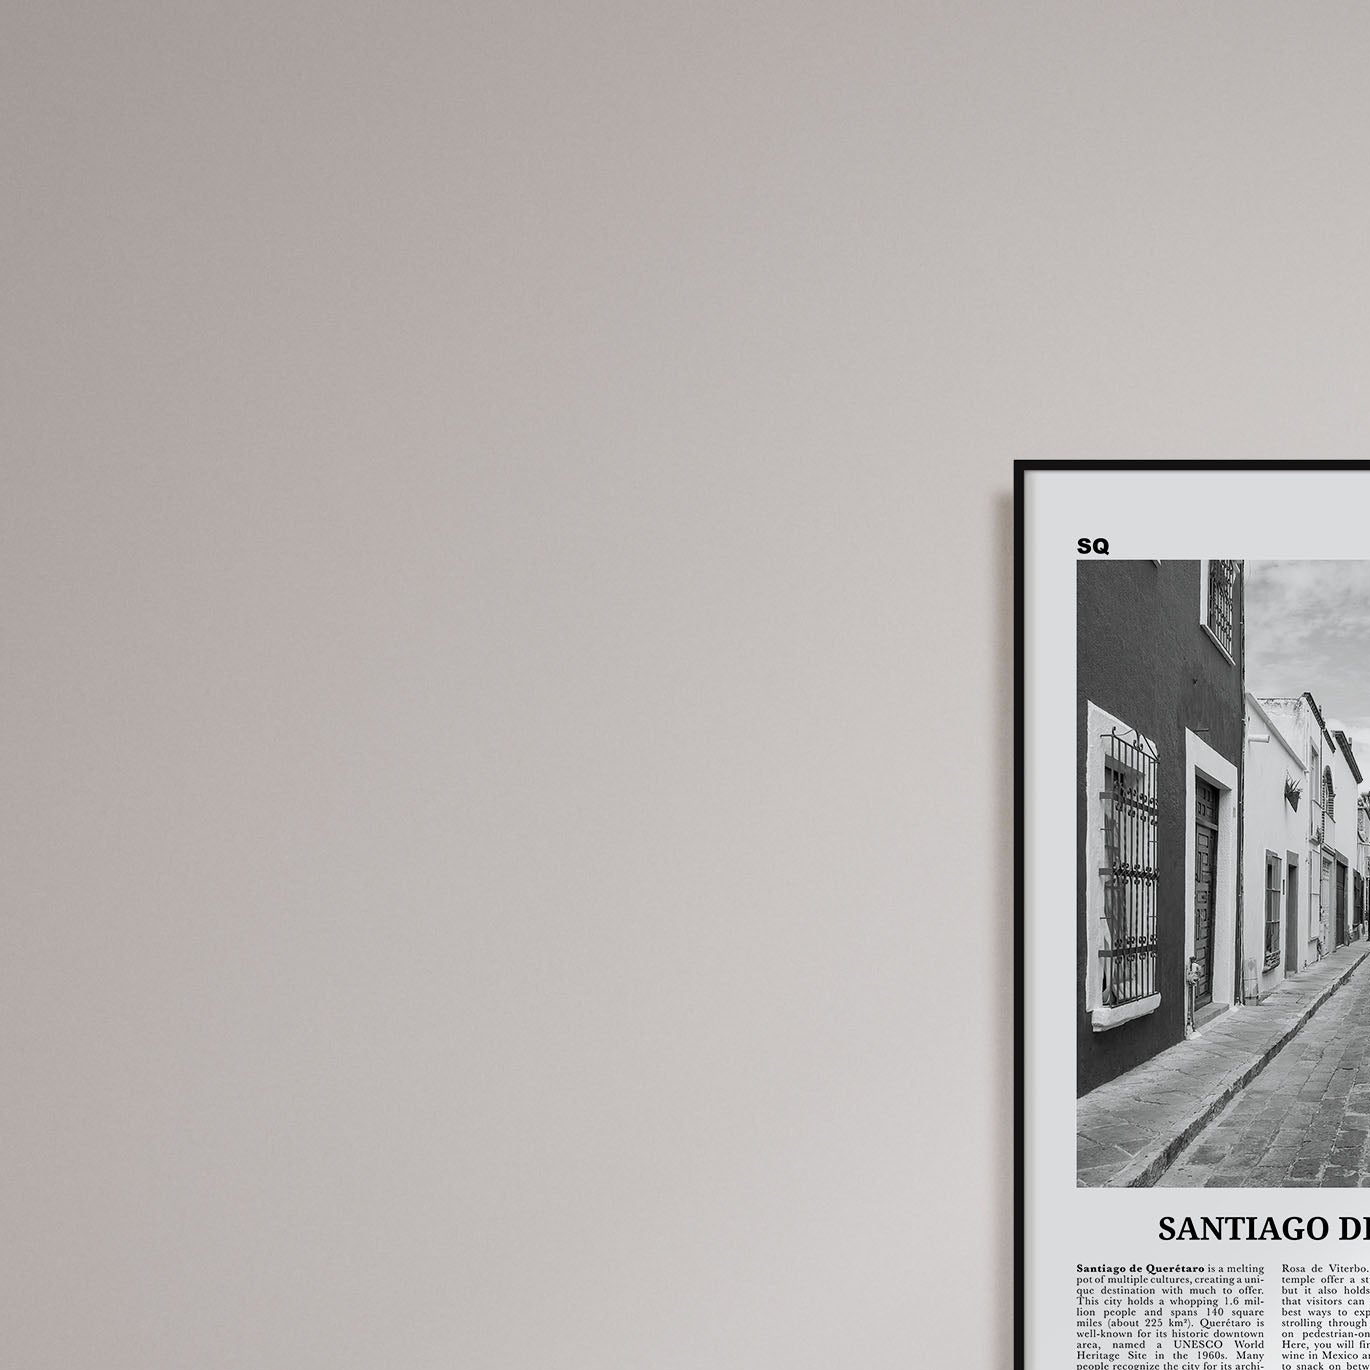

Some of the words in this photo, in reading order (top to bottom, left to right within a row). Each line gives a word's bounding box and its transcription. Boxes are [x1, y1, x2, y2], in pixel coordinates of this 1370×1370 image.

[1077, 538, 1109, 555] SQ
[1159, 1217, 1329, 1240] SANTIAGO
[1077, 1264, 1126, 1276] Santiago
[1129, 1264, 1143, 1273] de
[1146, 1264, 1205, 1276] Querétaro
[1208, 1264, 1215, 1273] is
[1218, 1265, 1224, 1273] a
[1227, 1264, 1264, 1276] melting
[1282, 1264, 1306, 1273] Rosa
[1311, 1264, 1323, 1273] de
[1329, 1264, 1369, 1273] Viterbo.
[1076, 1275, 1093, 1286] pot
[1094, 1275, 1106, 1284] of
[1108, 1275, 1148, 1286] multiple
[1150, 1275, 1192, 1285] cultures,
[1194, 1275, 1235, 1286] creating
[1236, 1276, 1242, 1284] a
[1244, 1275, 1264, 1284] uni-
[1282, 1275, 1315, 1286] temple
[1321, 1275, 1344, 1284] offer
[1349, 1276, 1355, 1284] a
[1076, 1297, 1099, 1305] This
[1104, 1297, 1122, 1308] city
[1127, 1297, 1154, 1305] holds
[1170, 1297, 1218, 1308] whopping
[1225, 1297, 1239, 1305] 1.6
[1244, 1297, 1264, 1305] mil-
[1282, 1297, 1301, 1305] that
[1306, 1297, 1342, 1305] visitors
[1076, 1307, 1095, 1316] lion
[1104, 1307, 1136, 1319] people
[1144, 1307, 1163, 1316] and
[1170, 1309, 1198, 1319] spans
[1207, 1307, 1224, 1316] 140
[1232, 1309, 1264, 1319] square
[1076, 1329, 1133, 1338] well-known
[1137, 1329, 1152, 1338] for
[1156, 1329, 1167, 1338] its
[1172, 1329, 1209, 1338] historic
[1213, 1329, 1264, 1338] downtown
[1076, 1341, 1101, 1350] area,
[1112, 1340, 1145, 1349] named
[1157, 1341, 1162, 1349] a
[1174, 1340, 1223, 1349] UNESCO
[1234, 1340, 1264, 1349] World
[1282, 1340, 1309, 1350] Here,
[1314, 1341, 1332, 1352] you
[1336, 1340, 1354, 1349] will
[1077, 1351, 1120, 1362] Heritage
[1128, 1351, 1147, 1360] Site
[1155, 1351, 1164, 1360] in
[1173, 1351, 1188, 1360] the
[1198, 1351, 1227, 1360] 1960s.
[1236, 1351, 1264, 1362] Many
